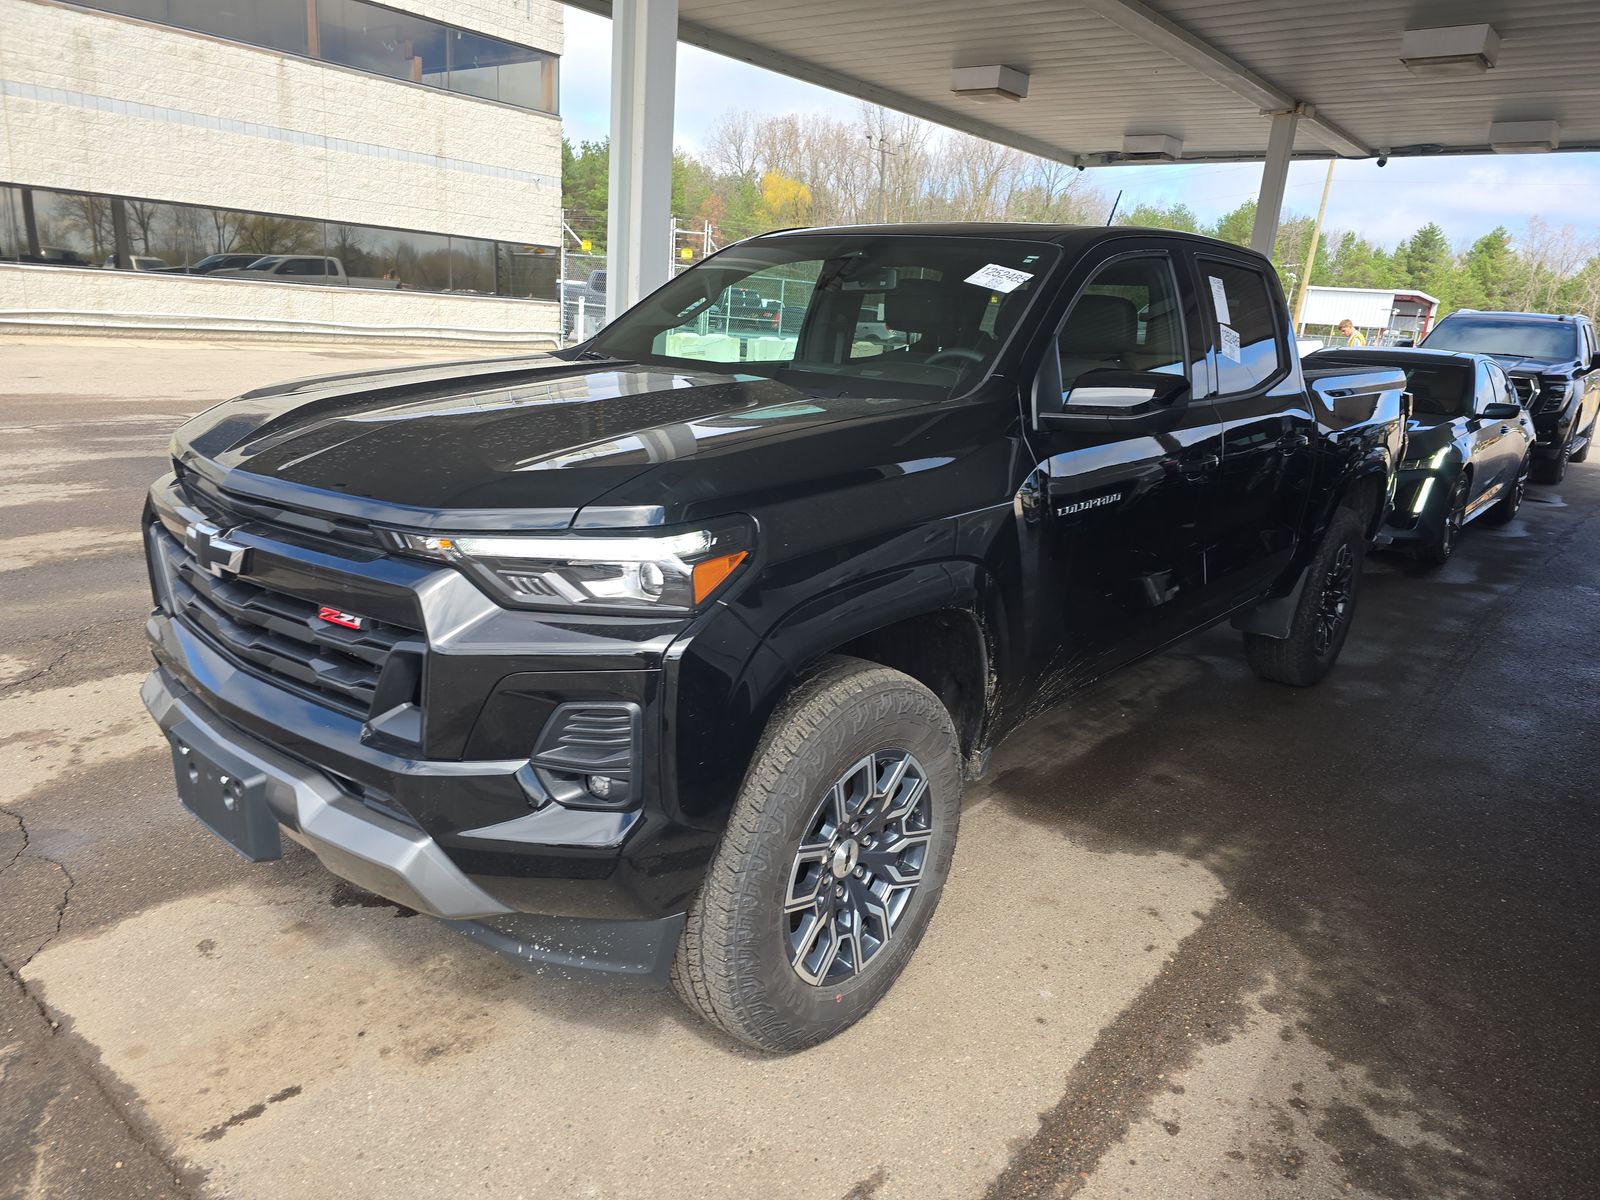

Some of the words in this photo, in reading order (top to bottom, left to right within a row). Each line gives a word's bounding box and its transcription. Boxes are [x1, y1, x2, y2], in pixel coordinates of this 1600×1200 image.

[981, 266, 1030, 284] 1252485
[1056, 492, 1122, 517] COLORADO
[318, 606, 364, 630] Z71
